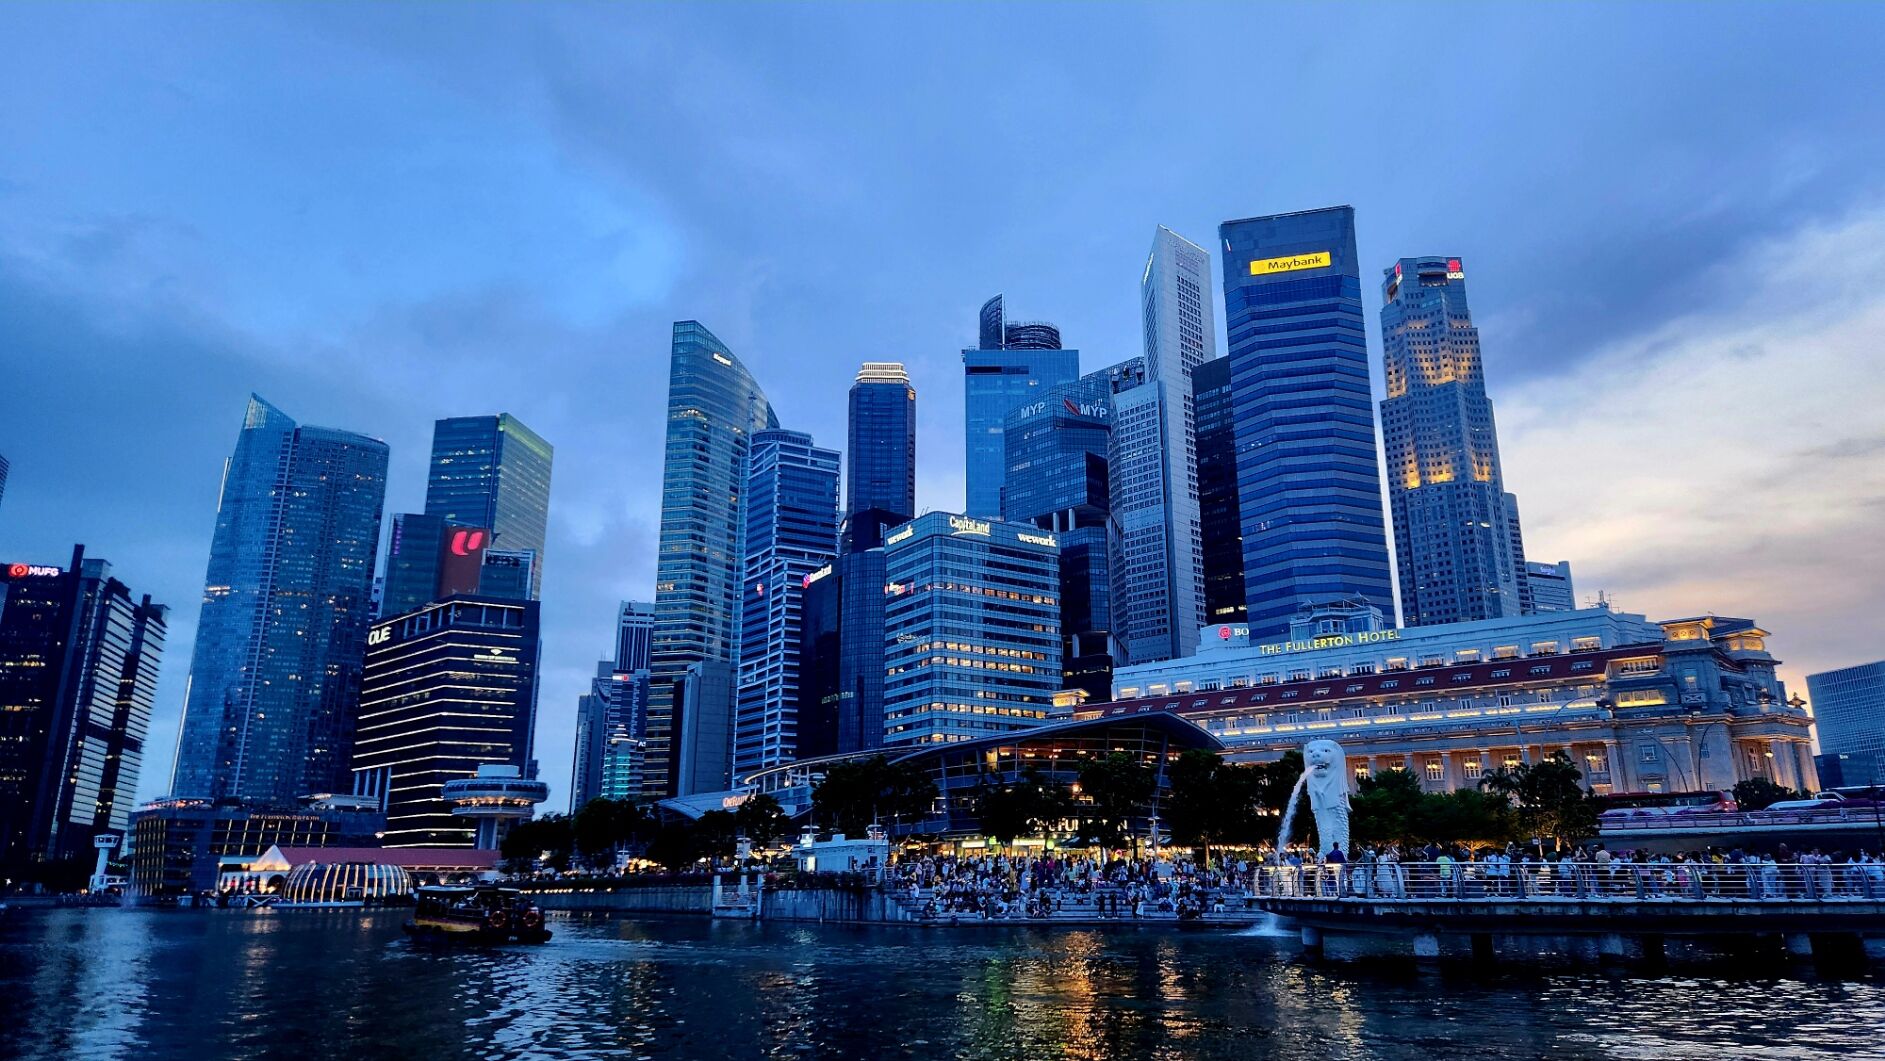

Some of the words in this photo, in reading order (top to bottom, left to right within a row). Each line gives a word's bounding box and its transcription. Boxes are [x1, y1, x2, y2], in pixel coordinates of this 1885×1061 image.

[1267, 256, 1322, 270] Maybank
[1021, 402, 1045, 418] MYP
[1080, 404, 1107, 418] MYP
[949, 516, 991, 533] CapitaLand
[1017, 533, 1057, 547] wework
[28, 566, 59, 577] MUFG
[368, 626, 392, 645] OUE
[1260, 645, 1282, 655] THE
[1286, 636, 1353, 652] FULLERTON
[1358, 630, 1401, 644] HOTEL
